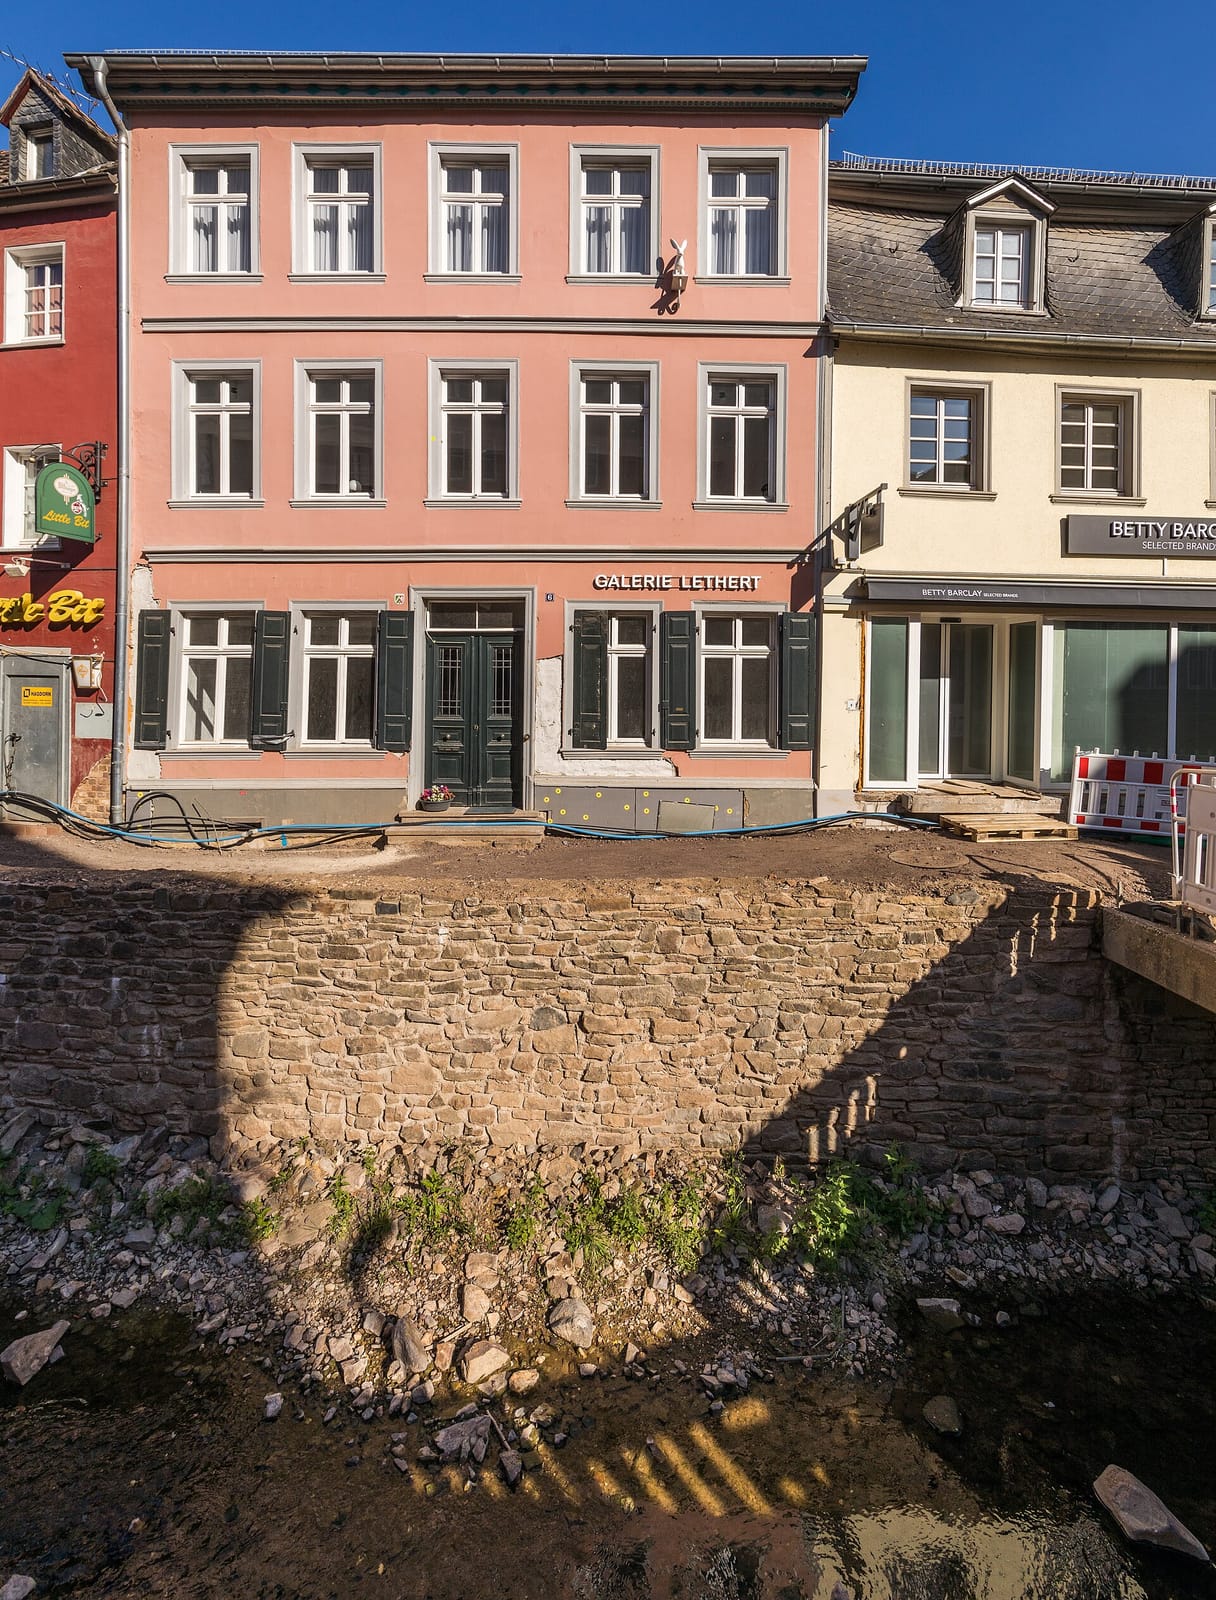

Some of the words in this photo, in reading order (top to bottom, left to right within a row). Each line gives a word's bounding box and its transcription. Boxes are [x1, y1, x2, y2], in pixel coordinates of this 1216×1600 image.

[42, 510, 71, 524] Little
[74, 515, 90, 529] Bit
[1113, 521, 1168, 537] BETTY
[1142, 541, 1185, 550] SELECTED
[1186, 542, 1216, 551] BRAND
[595, 575, 672, 588] GALERIE
[681, 576, 762, 589] LETHERT
[947, 589, 982, 597] BARCLAY
[48, 589, 105, 623] Bit
